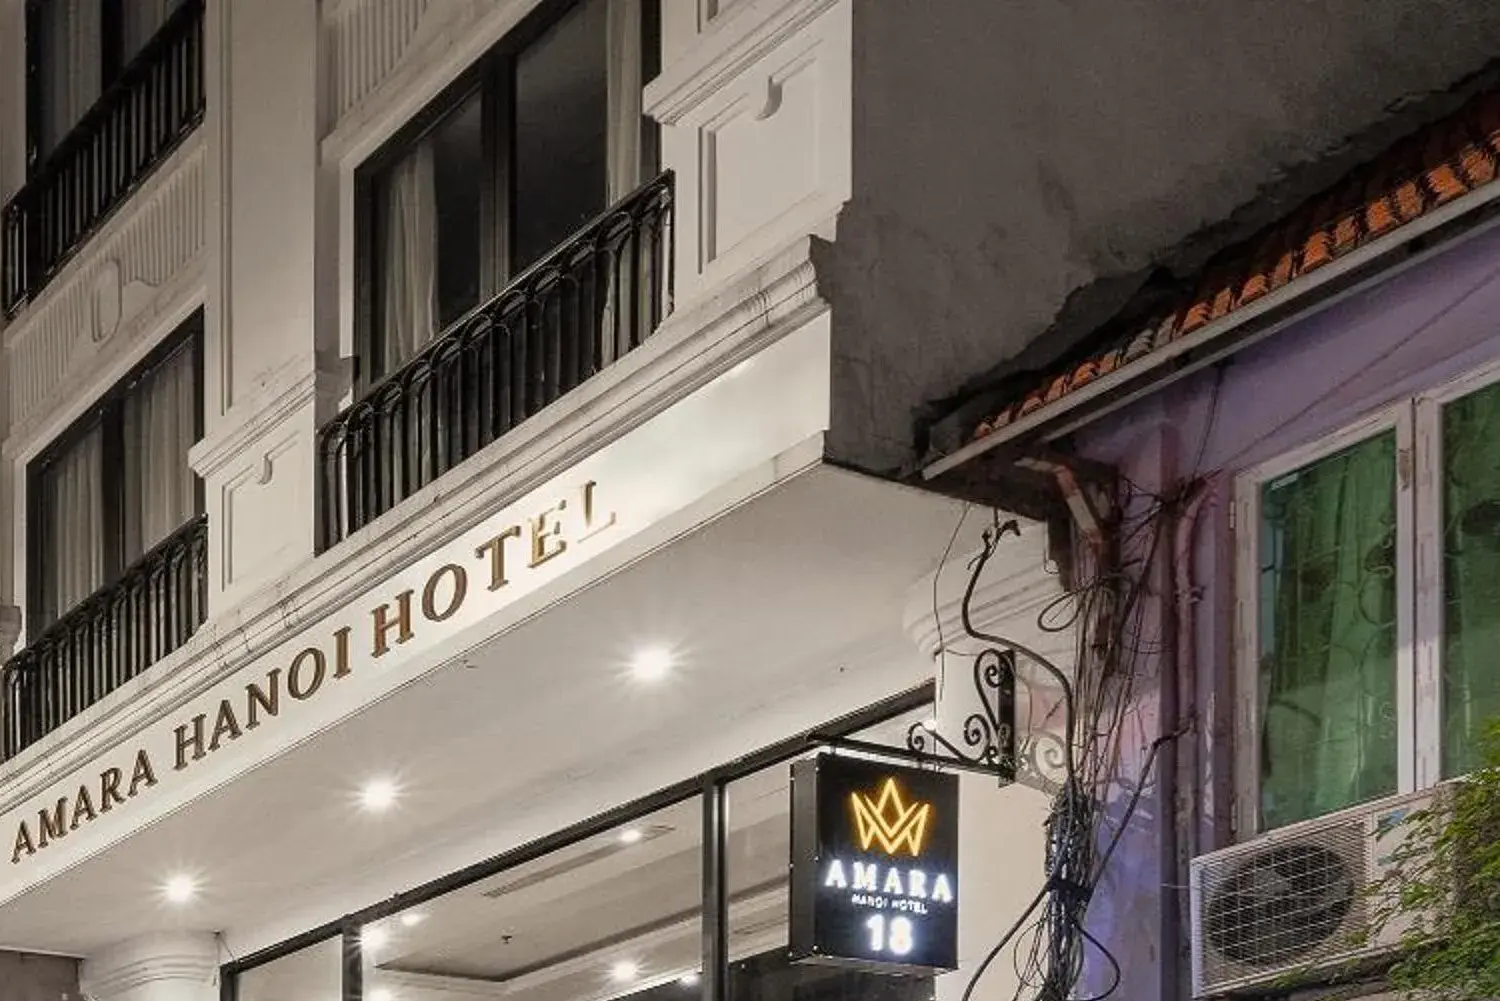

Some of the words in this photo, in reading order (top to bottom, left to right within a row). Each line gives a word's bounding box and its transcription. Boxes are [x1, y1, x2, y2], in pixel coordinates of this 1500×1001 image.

[10, 749, 158, 865] AMARA
[174, 625, 352, 771] HANOI
[370, 479, 617, 658] HOTEL
[824, 858, 954, 904] AMARA
[851, 893, 888, 909] HANOI
[891, 899, 928, 915] HOTEL
[865, 914, 913, 955] 18
